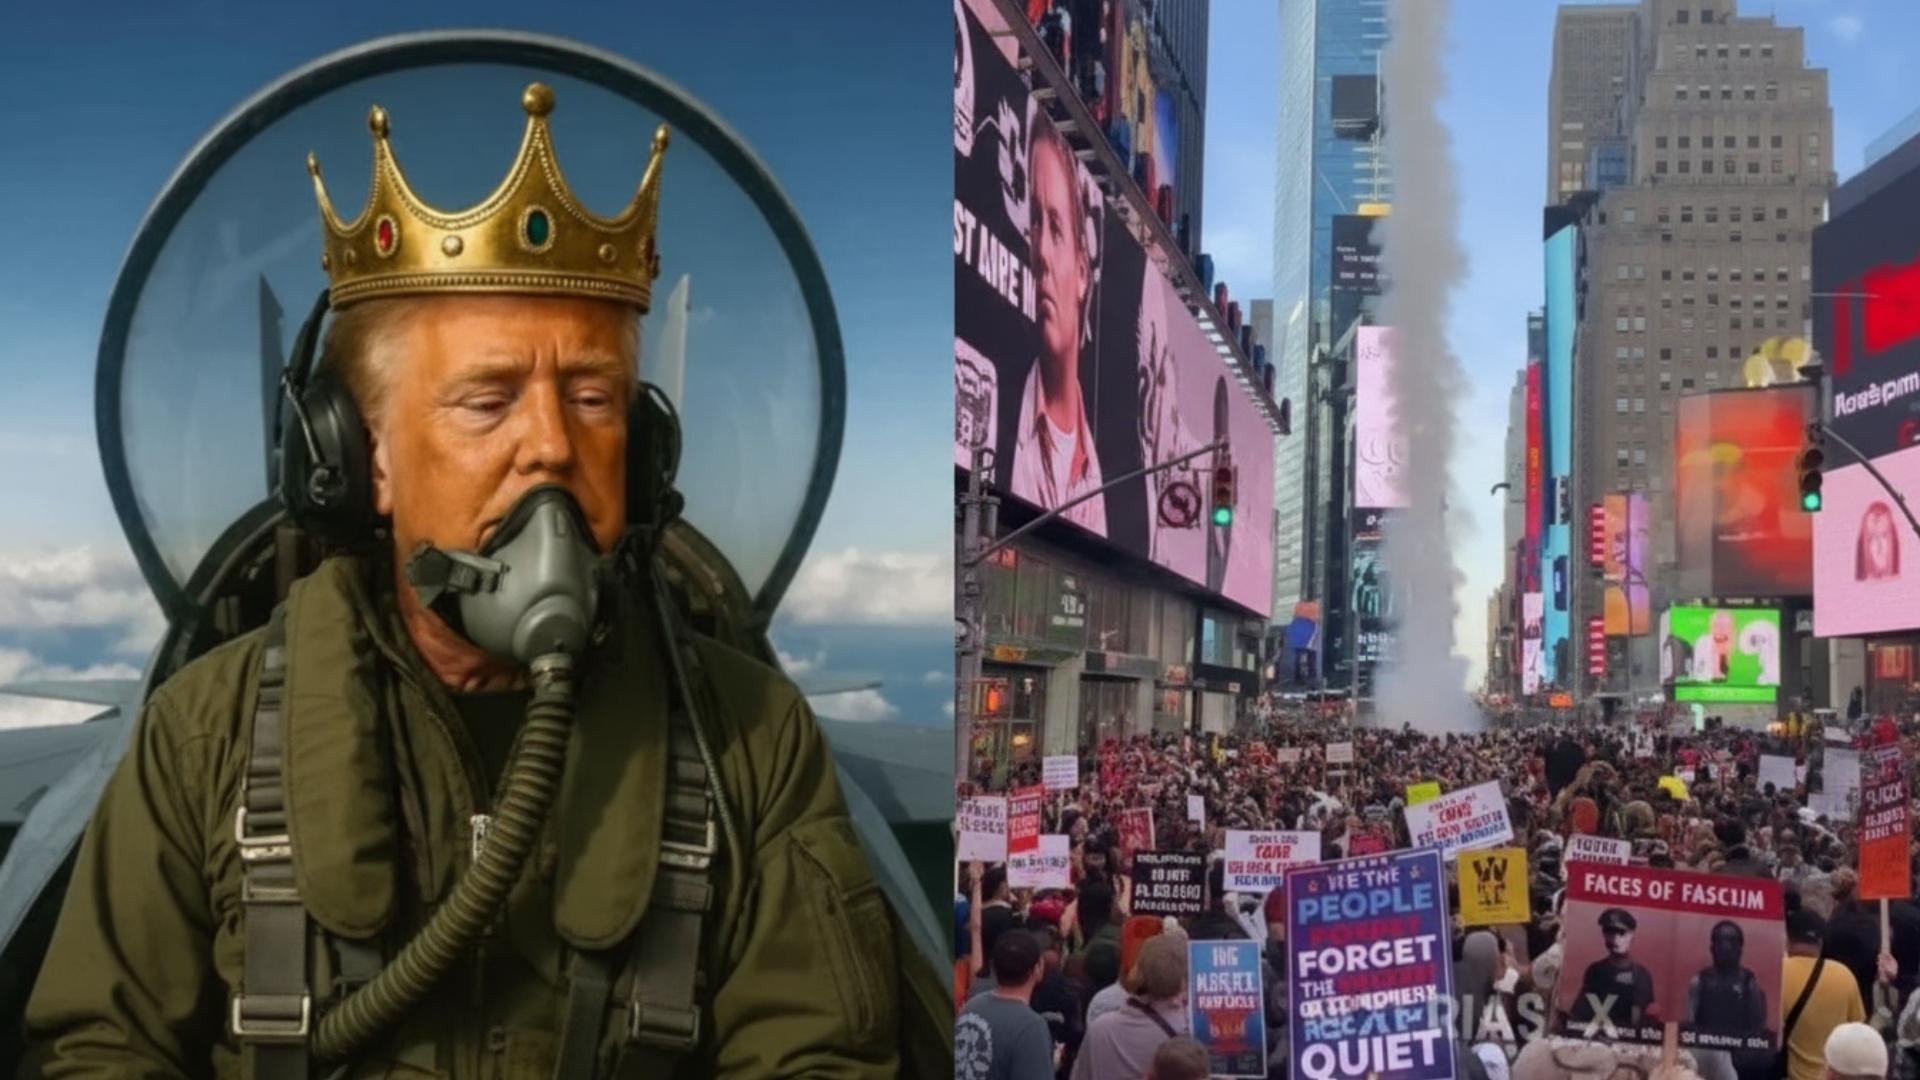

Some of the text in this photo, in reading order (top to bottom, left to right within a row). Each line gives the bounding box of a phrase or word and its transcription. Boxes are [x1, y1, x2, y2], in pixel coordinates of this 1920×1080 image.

[1362, 867, 1401, 887] THE
[1584, 873, 1642, 898] FACES
[1648, 881, 1674, 900] OF
[1298, 882, 1434, 925] PEOPLE
[1298, 934, 1437, 978] FORGET
[1301, 979, 1336, 998] THE
[1301, 1028, 1442, 1080] QUIET
